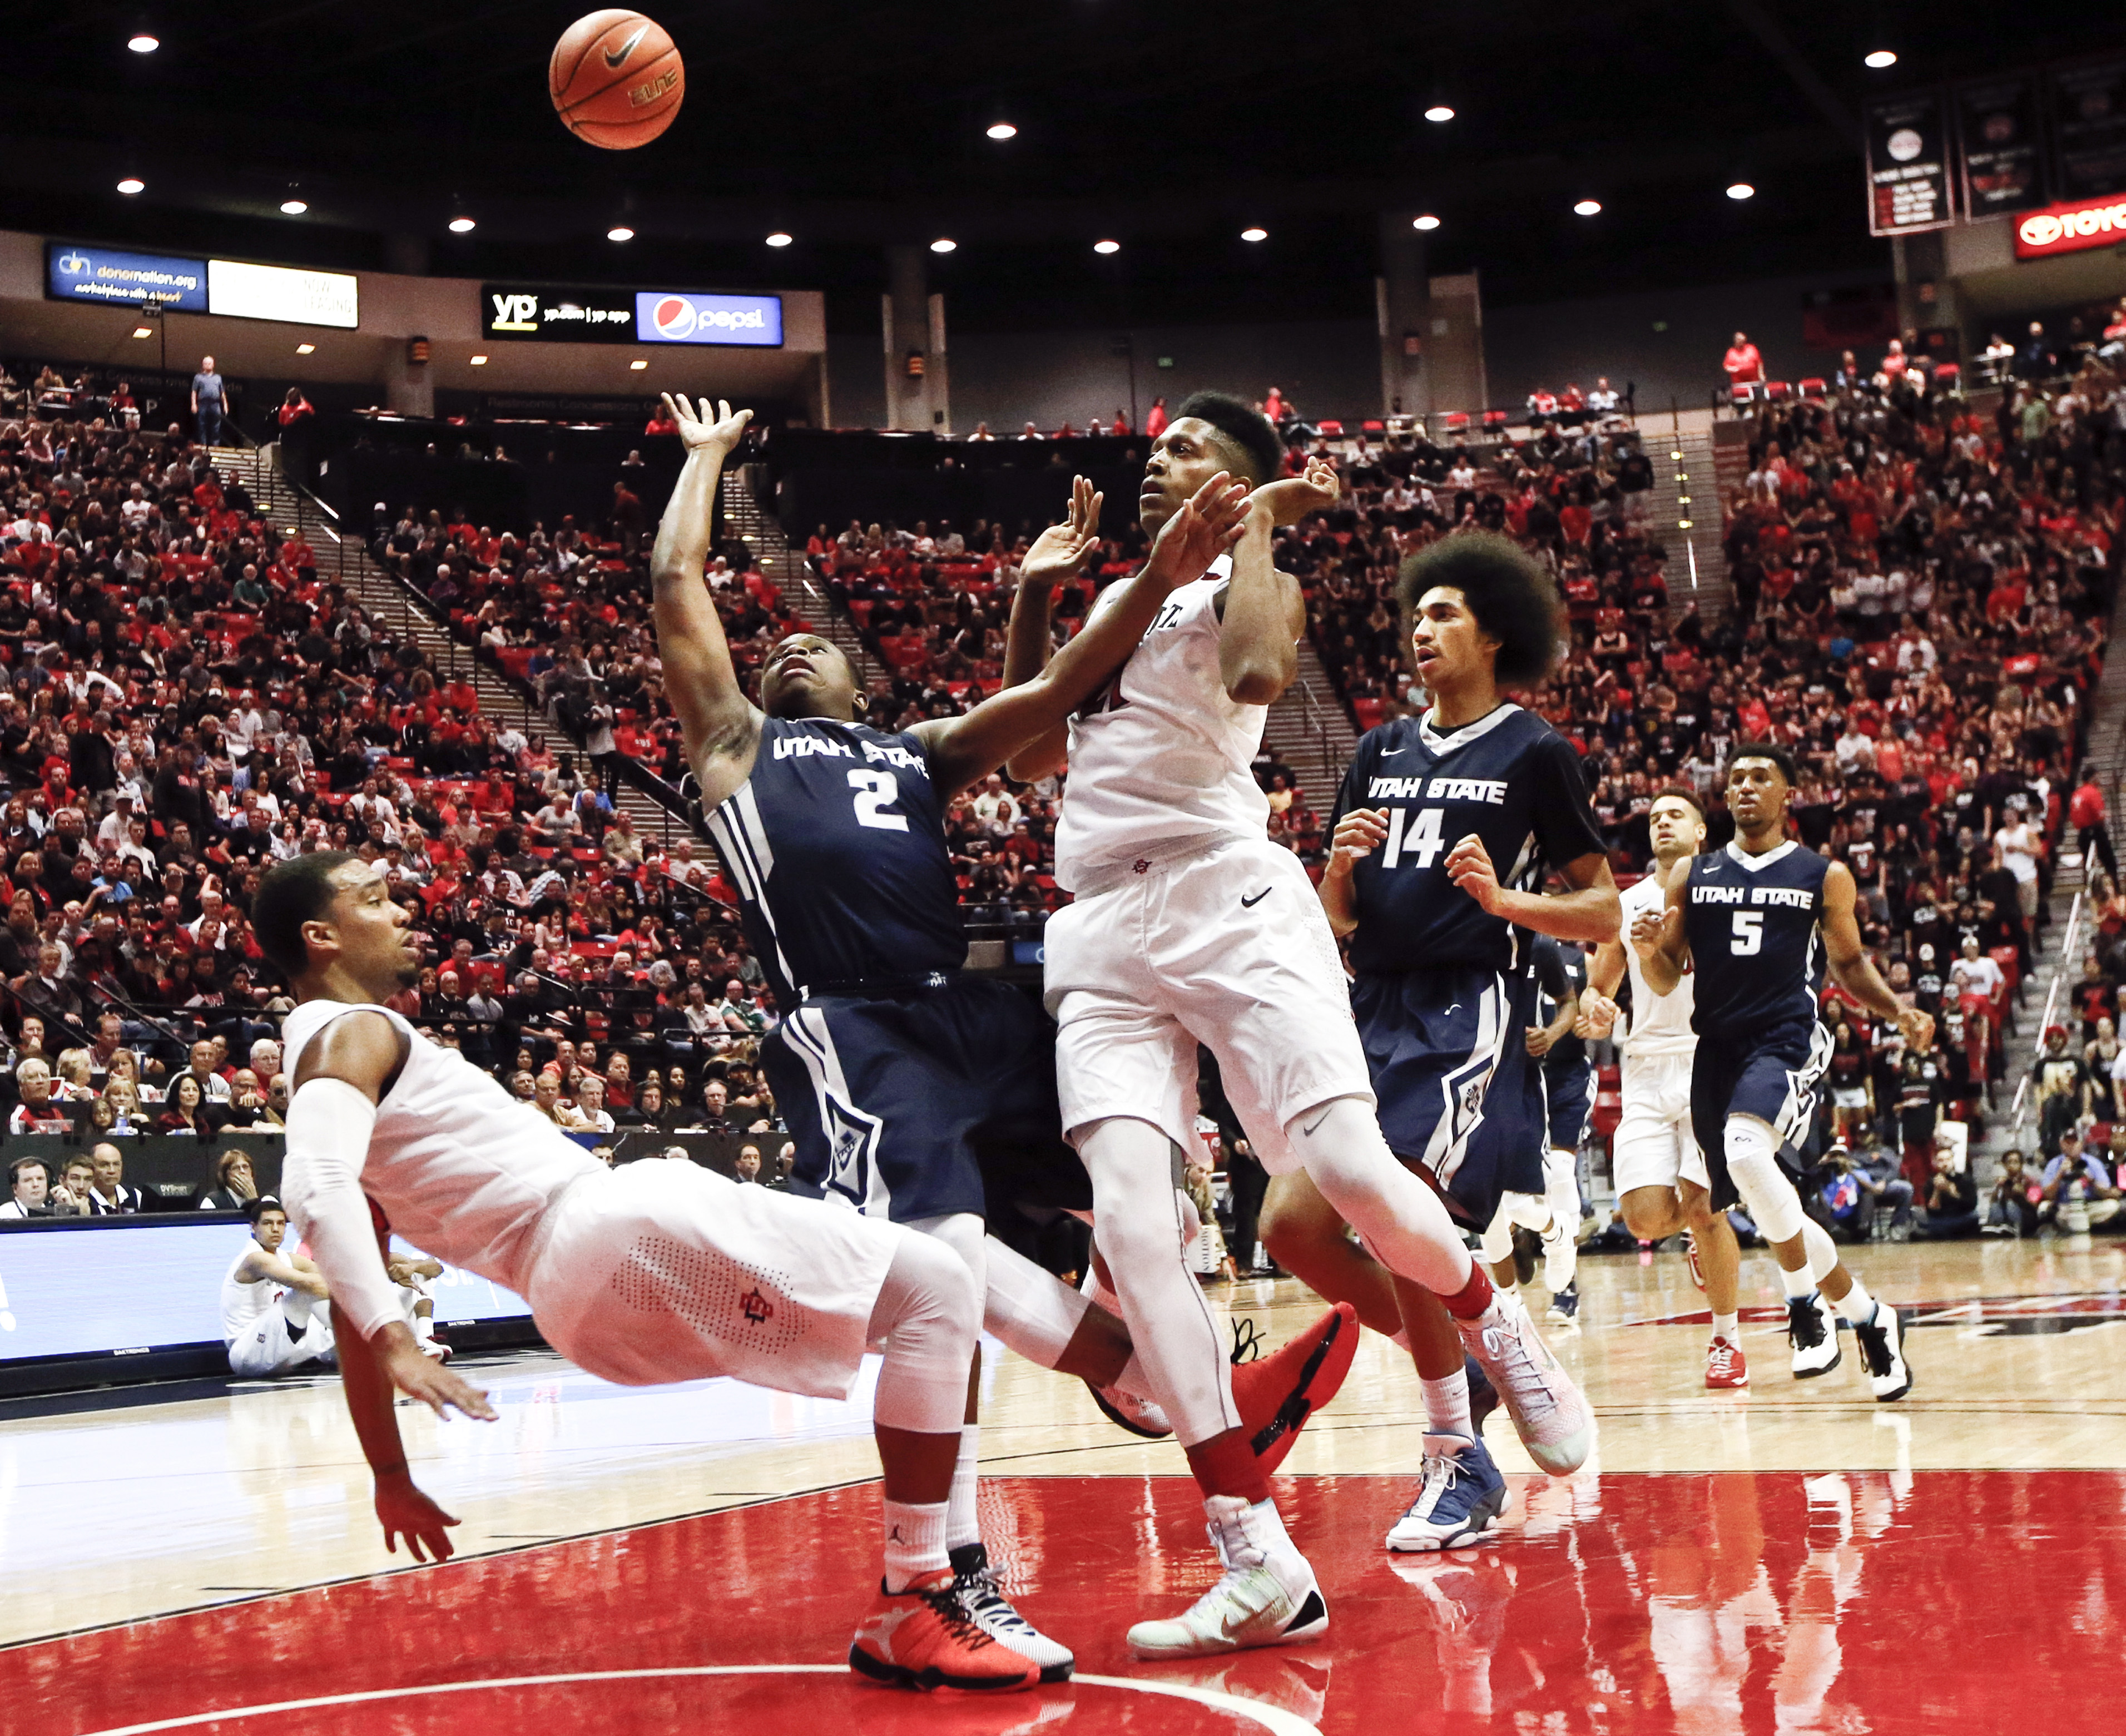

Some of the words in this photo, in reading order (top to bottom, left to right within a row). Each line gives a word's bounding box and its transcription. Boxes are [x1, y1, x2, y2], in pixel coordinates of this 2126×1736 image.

[628, 67, 677, 108] ELITE
[97, 266, 197, 291] donornation.org
[304, 278, 331, 294] NOW
[130, 287, 147, 299] with
[304, 296, 351, 313] LEASING
[492, 295, 538, 324] yp
[544, 309, 585, 321] yp.com
[592, 310, 607, 323] yp
[608, 311, 631, 324] app
[698, 309, 765, 331] pepsi
[772, 735, 856, 760] UTAH
[846, 768, 910, 833] 2
[1367, 776, 1423, 798] UTAH
[1426, 778, 1508, 805] STATE
[1381, 807, 1445, 869] 14
[1691, 886, 1745, 905] UTAH
[1751, 887, 1814, 910] STATE
[1730, 910, 1764, 956] 5
[113, 1347, 150, 1356] DAKTRONICS
